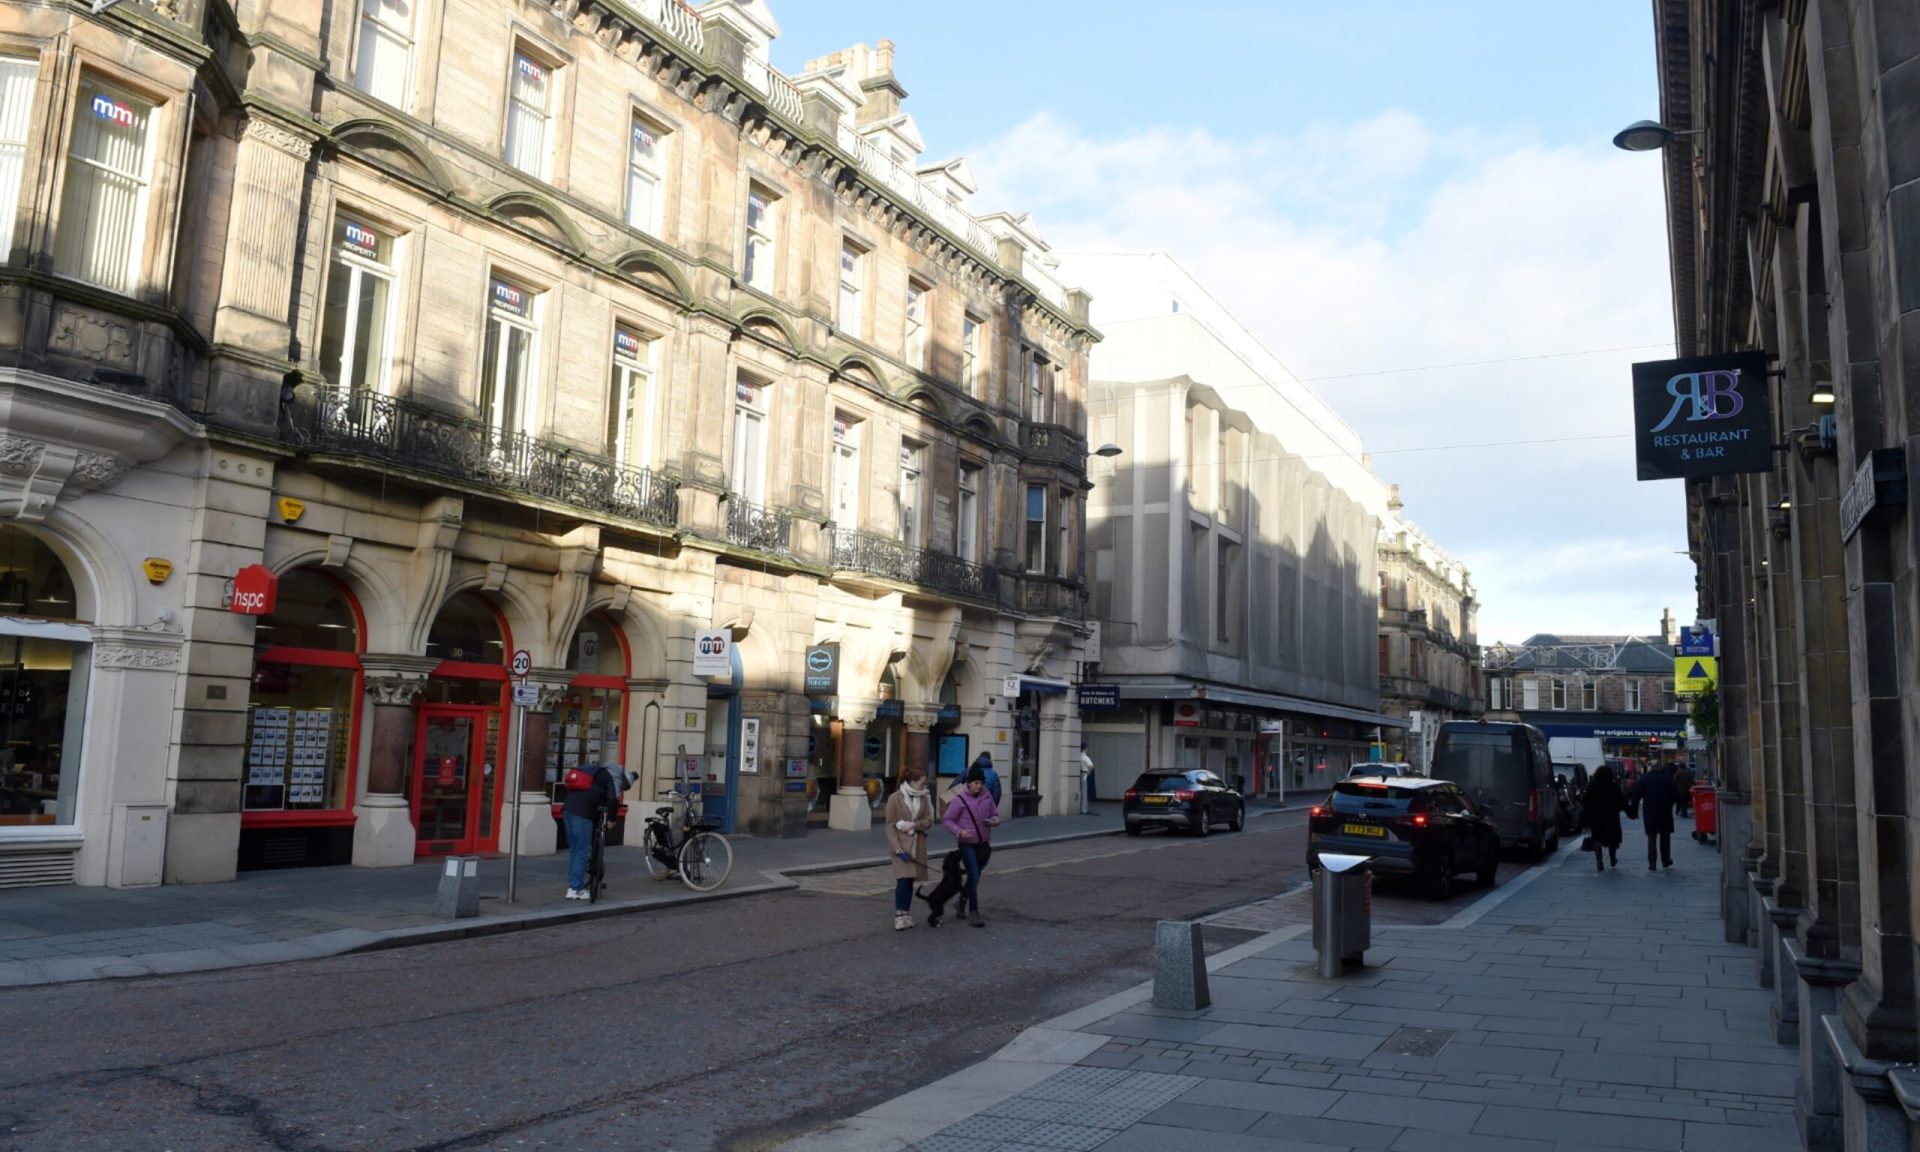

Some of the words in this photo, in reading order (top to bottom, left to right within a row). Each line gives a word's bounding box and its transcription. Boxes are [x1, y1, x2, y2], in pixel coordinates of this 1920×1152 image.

[92, 96, 133, 125] mm
[346, 224, 376, 247] mm
[496, 284, 520, 303] mm
[1653, 428, 1751, 448] RESTAURANT
[1680, 448, 1691, 461] &
[1696, 446, 1725, 459] BAR
[233, 587, 265, 613] hspc
[514, 657, 529, 669] 20
[1080, 696, 1115, 706] BUTCHERS
[1606, 729, 1634, 737] original
[1659, 730, 1677, 738] shop
